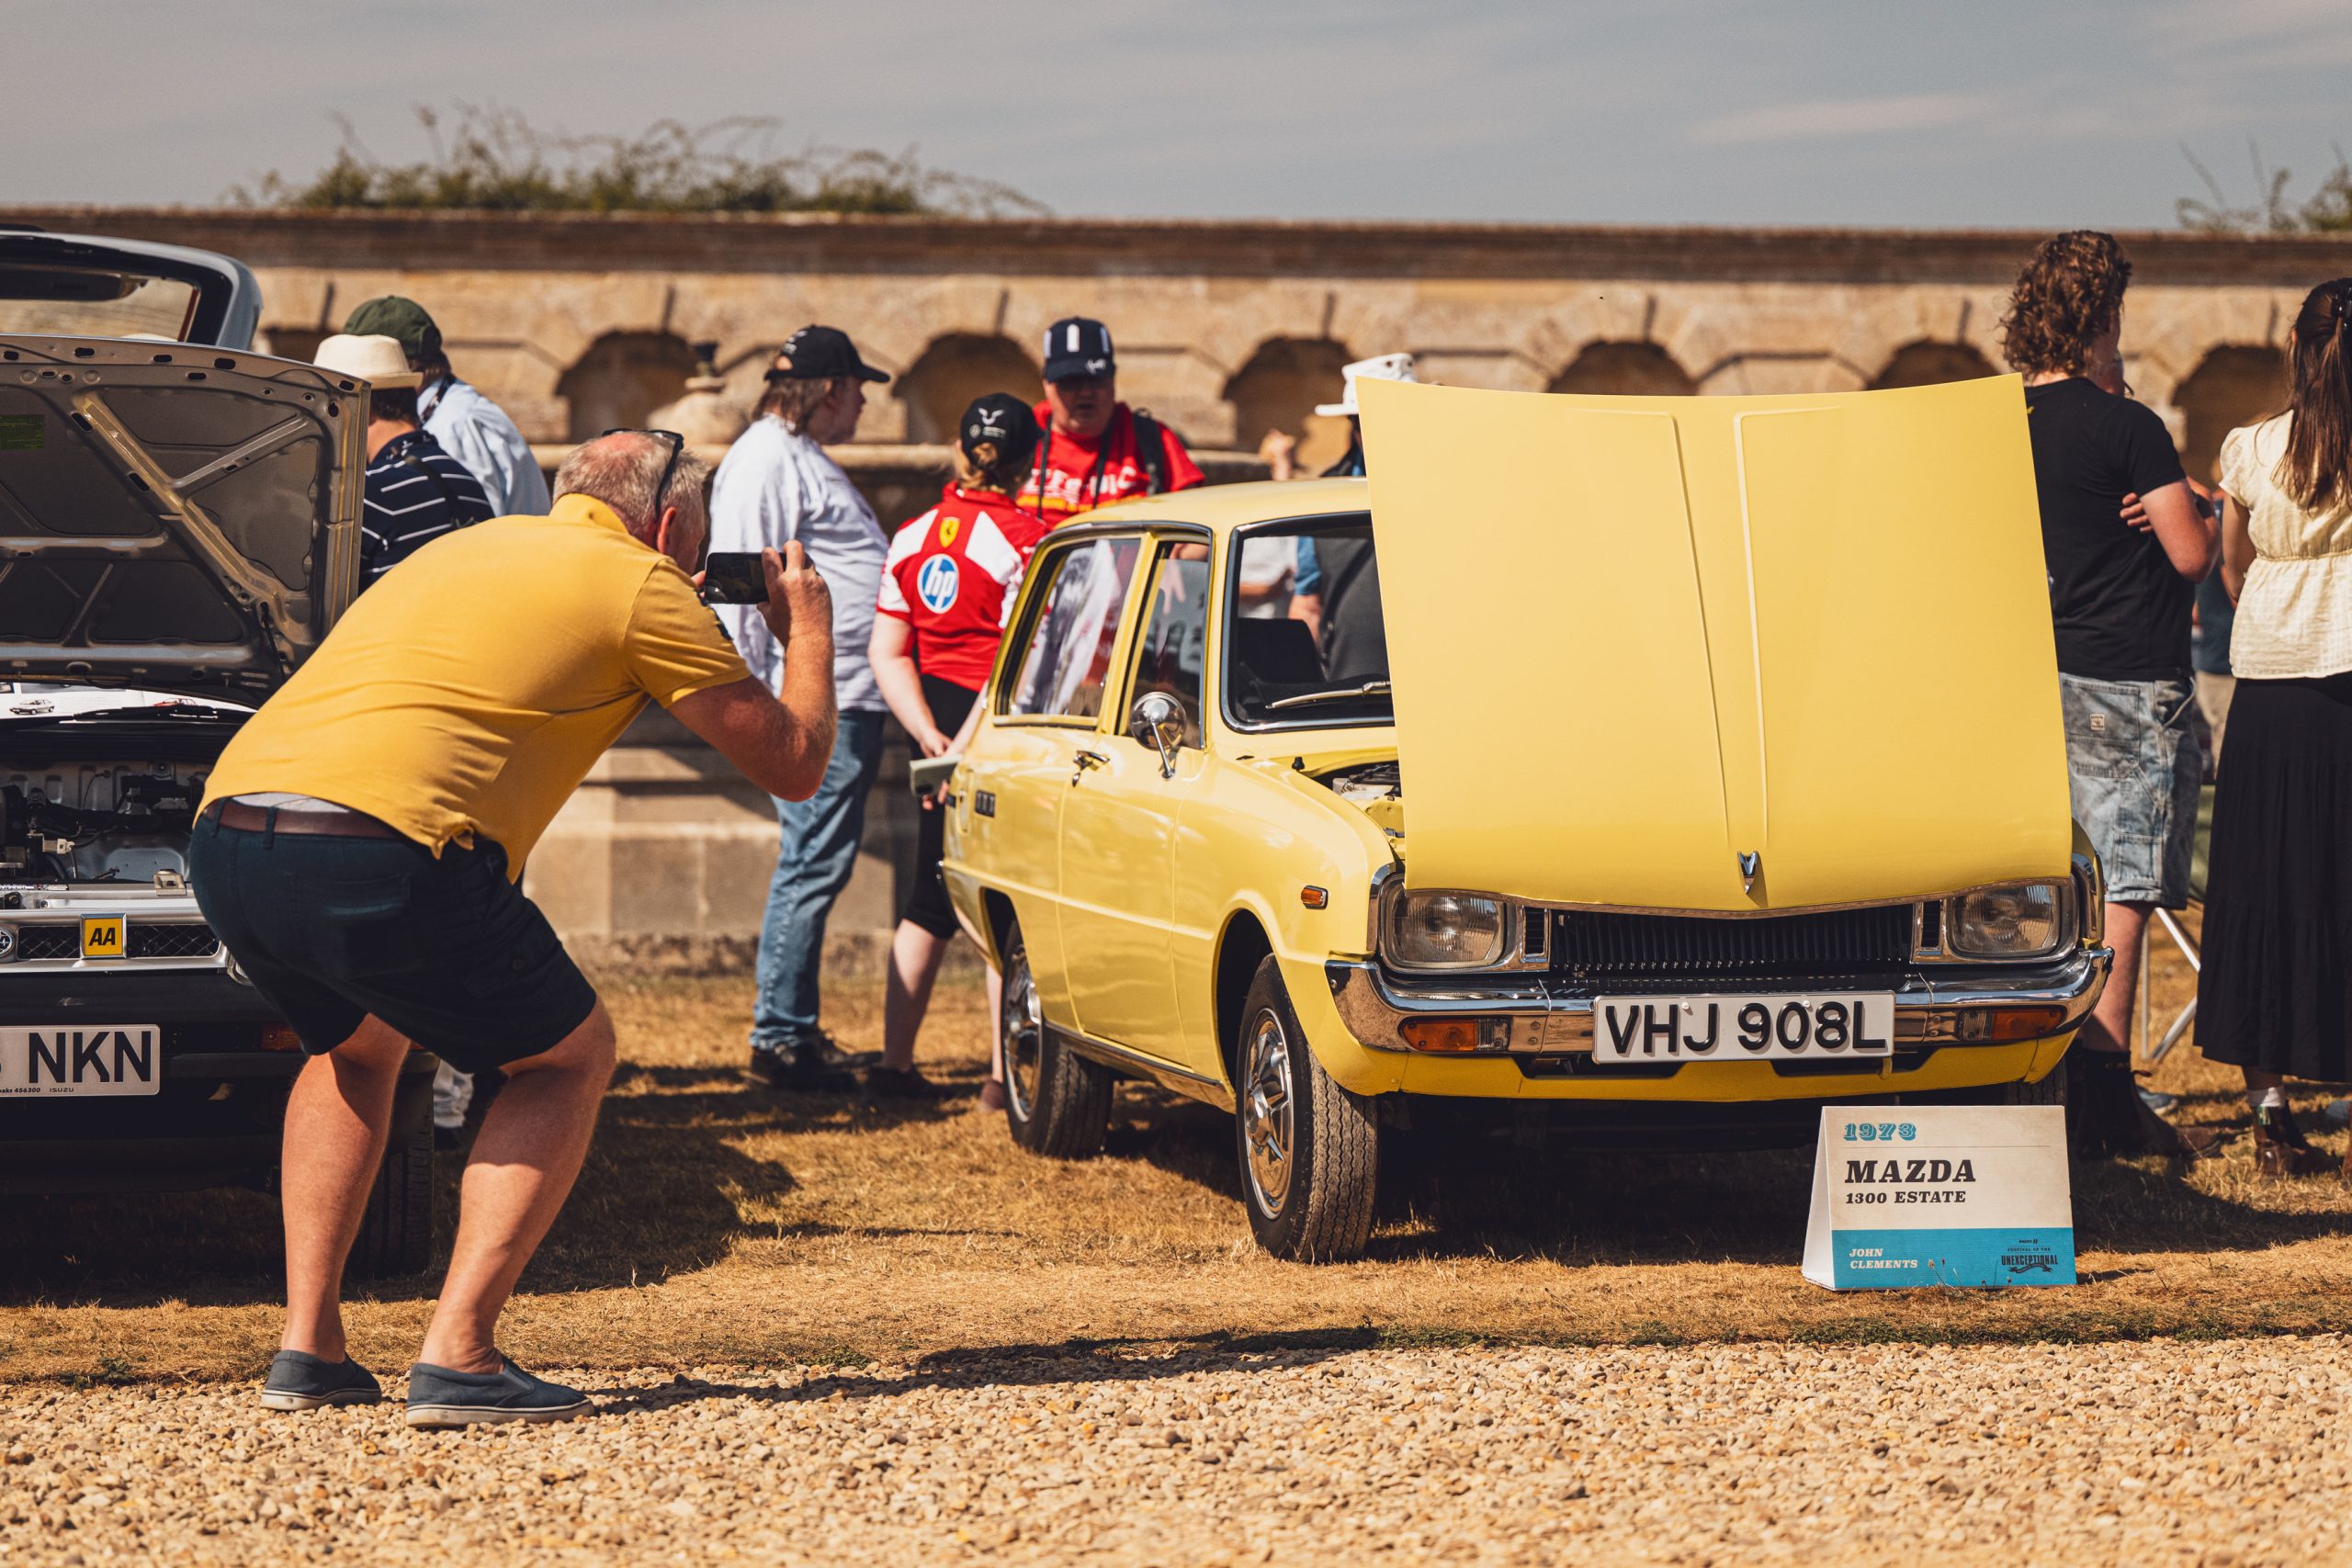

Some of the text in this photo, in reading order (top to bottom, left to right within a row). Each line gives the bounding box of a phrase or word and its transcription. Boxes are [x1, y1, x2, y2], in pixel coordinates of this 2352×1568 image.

[924, 555, 956, 612] hp
[88, 927, 116, 946] AA
[1605, 1000, 1886, 1055] VHJ 908L
[28, 1031, 152, 1084] NKN
[1843, 1122, 1917, 1142] 1973
[1844, 1159, 1976, 1183] MAZDA
[1846, 1190, 1966, 1204] 1300 ESTATE
[1849, 1248, 1883, 1258] JOHN
[2000, 1255, 2058, 1265] UNEXCEPTIONAL
[1849, 1259, 1918, 1269] CLEMENTS
